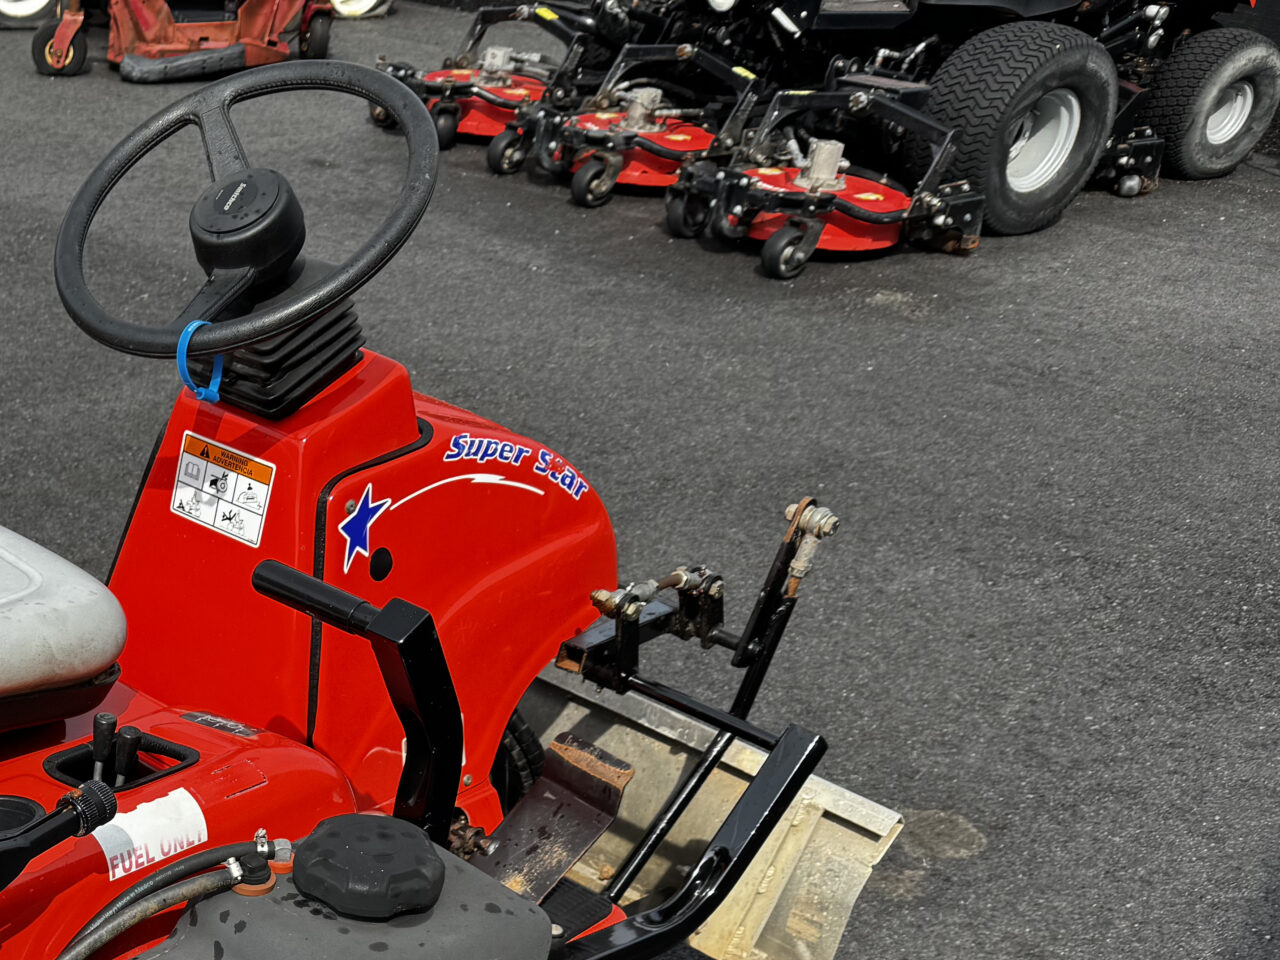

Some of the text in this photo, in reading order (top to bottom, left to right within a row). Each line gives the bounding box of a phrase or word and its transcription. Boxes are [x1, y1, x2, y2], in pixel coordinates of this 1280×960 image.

[221, 451, 249, 466] WARNING
[443, 433, 531, 465] Super
[213, 456, 253, 476] ADVERTENCIA
[109, 843, 155, 878] FUEL
